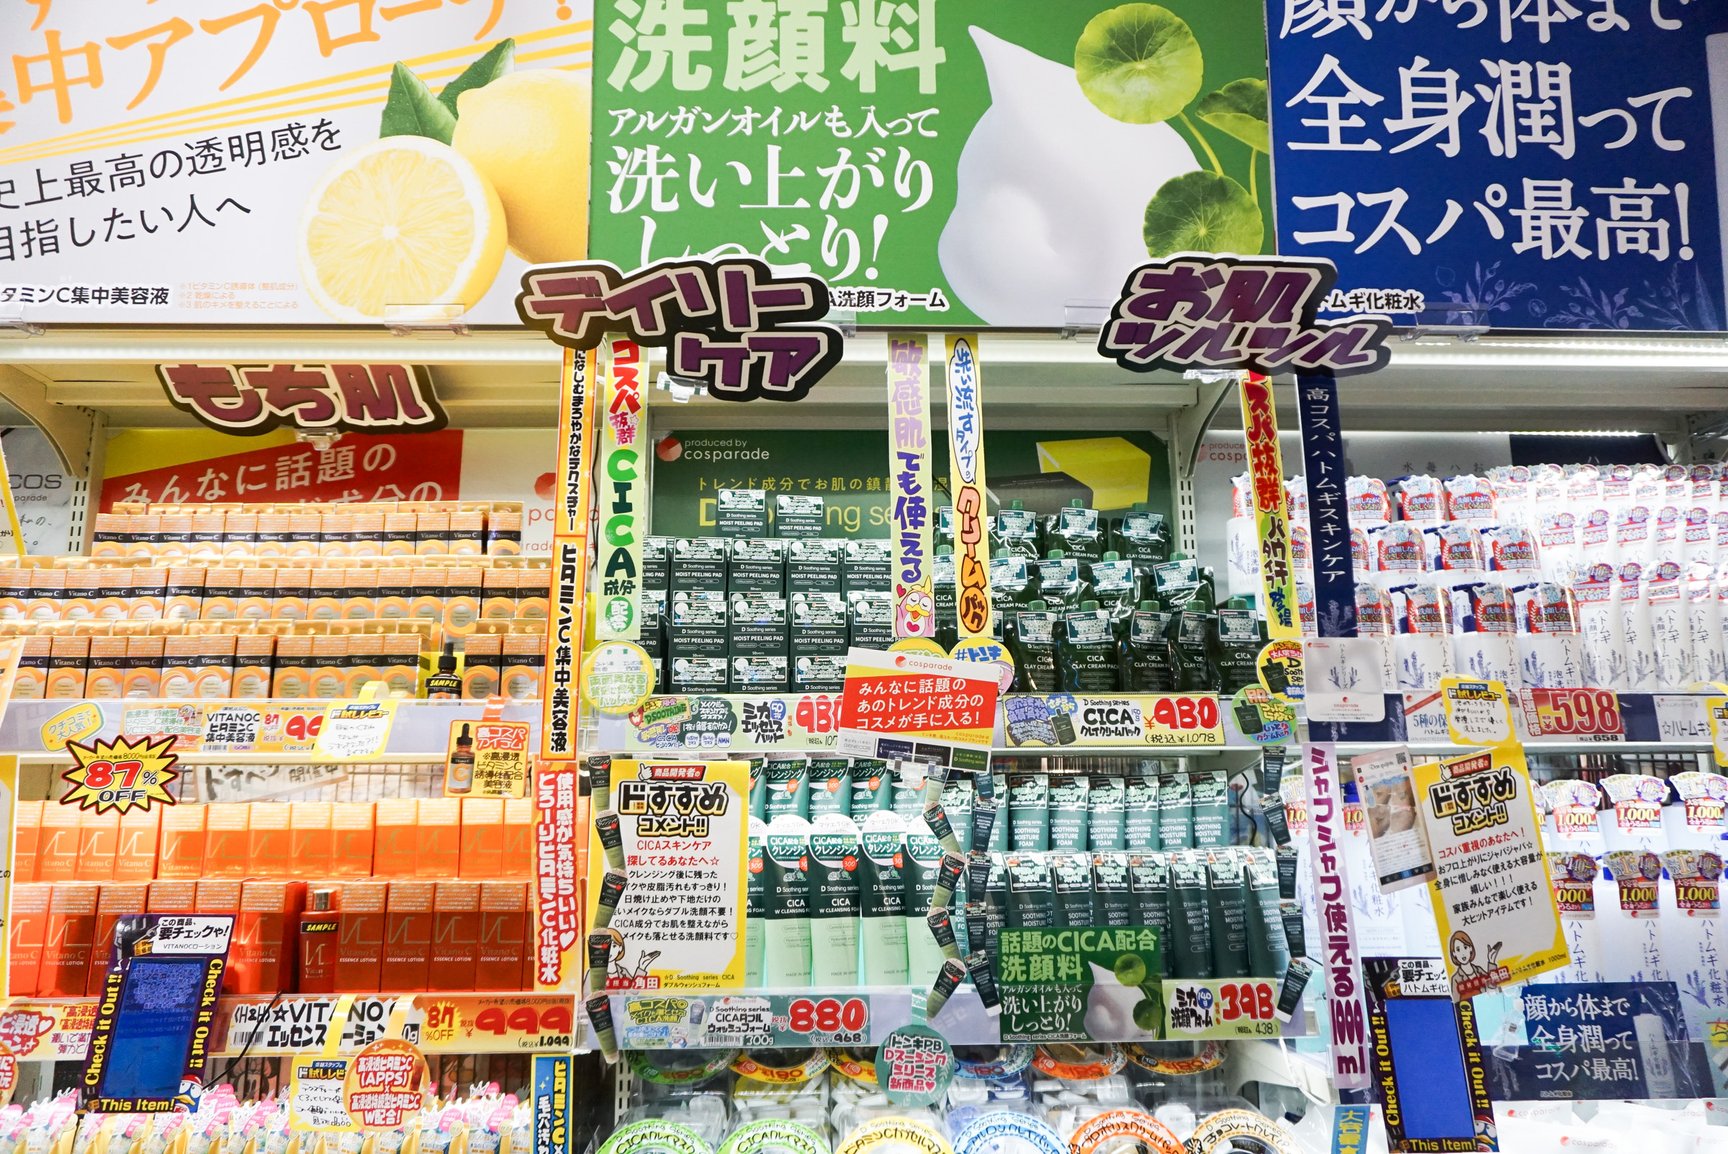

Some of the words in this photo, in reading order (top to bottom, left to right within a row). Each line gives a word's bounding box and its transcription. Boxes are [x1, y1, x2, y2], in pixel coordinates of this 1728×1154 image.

[606, 0, 946, 95] 洗顔料
[1285, 53, 1694, 160] 全身潤って
[607, 105, 940, 140] アルガンオイルも入って
[604, 144, 934, 214] 洗い上がり
[1292, 177, 1696, 263] コスパ最高!
[1124, 263, 1318, 326] お肌
[675, 332, 828, 392] ケア
[162, 364, 434, 426] もち肌
[684, 448, 770, 463] cosparade
[890, 339, 927, 584] 敏感肌でも使える
[119, 442, 397, 503] みんなに話題の
[428, 678, 458, 688] SAMPLE
[858, 678, 967, 697] みんなに話題の
[856, 693, 985, 714] あのトレンド成分の
[1082, 707, 1135, 726] CICA
[1153, 696, 1221, 730] 980
[1552, 690, 1617, 734] 598
[475, 725, 528, 739] 高コスパ
[97, 789, 148, 803] OFF
[636, 839, 712, 851] CICAスキンケア
[624, 894, 722, 905] 日焼け止めや下地だけの
[831, 897, 851, 907] CICA
[306, 922, 338, 932] SAMPLE
[1001, 929, 1158, 955] 話題のCICA配合
[201, 957, 224, 1008] Check
[1001, 954, 1084, 982] 洗顔料
[1001, 984, 1083, 994] アルガンオイルも入って
[1219, 983, 1275, 1021] 398
[474, 1006, 573, 1035] 999
[788, 998, 868, 1034] 880
[1002, 996, 1083, 1016] 洗い上がり
[1524, 992, 1631, 1022] 顔から体まで
[1458, 999, 1473, 1048] Check
[745, 1034, 774, 1046] 300g
[1530, 1024, 1634, 1054] 全身潤って
[84, 1034, 108, 1086] Check
[100, 1098, 134, 1112] This
[1386, 1081, 1400, 1127] Check
[1409, 1137, 1441, 1152] This
